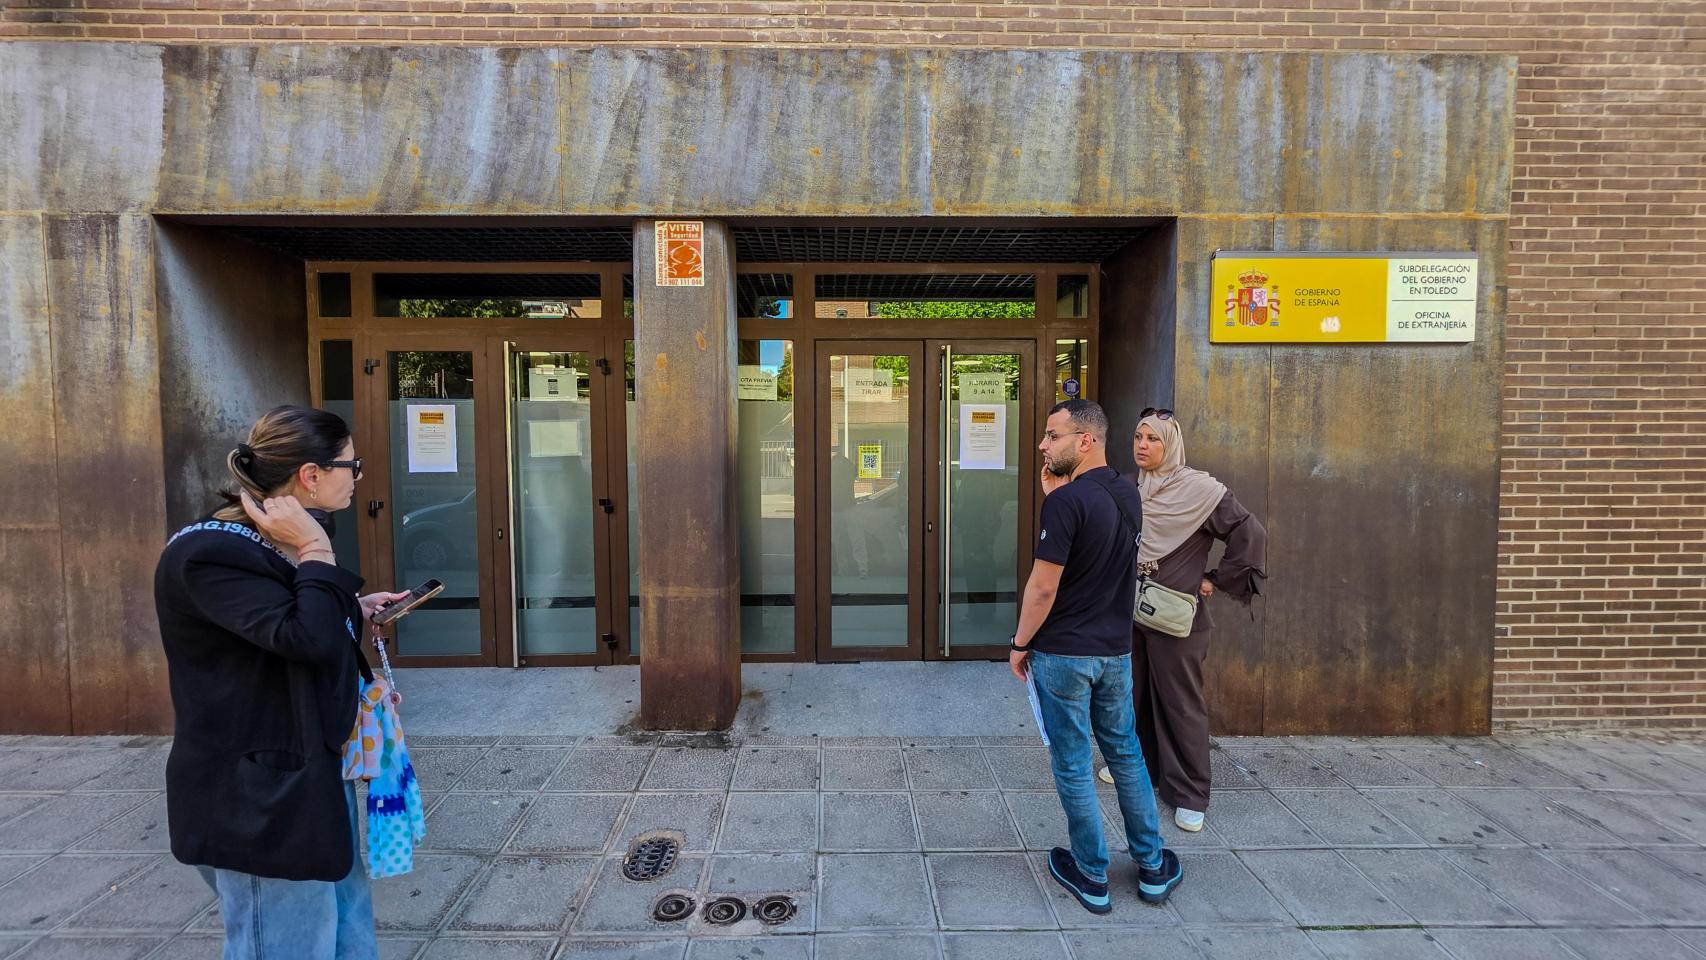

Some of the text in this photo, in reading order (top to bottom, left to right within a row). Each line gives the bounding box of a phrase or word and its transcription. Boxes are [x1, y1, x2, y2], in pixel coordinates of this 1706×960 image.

[669, 223, 700, 232] VITEN
[1398, 263, 1471, 274] SUBDELEGACIÓN
[1402, 276, 1466, 284] DEL GOBIERNO
[1294, 288, 1341, 297] GOBIERNO
[1409, 286, 1459, 295] EN TOLEDO
[1294, 297, 1340, 307] DE ESPAÑA
[1414, 311, 1451, 320] OFICINA
[1398, 320, 1468, 330] DE EXTRANJERÍA
